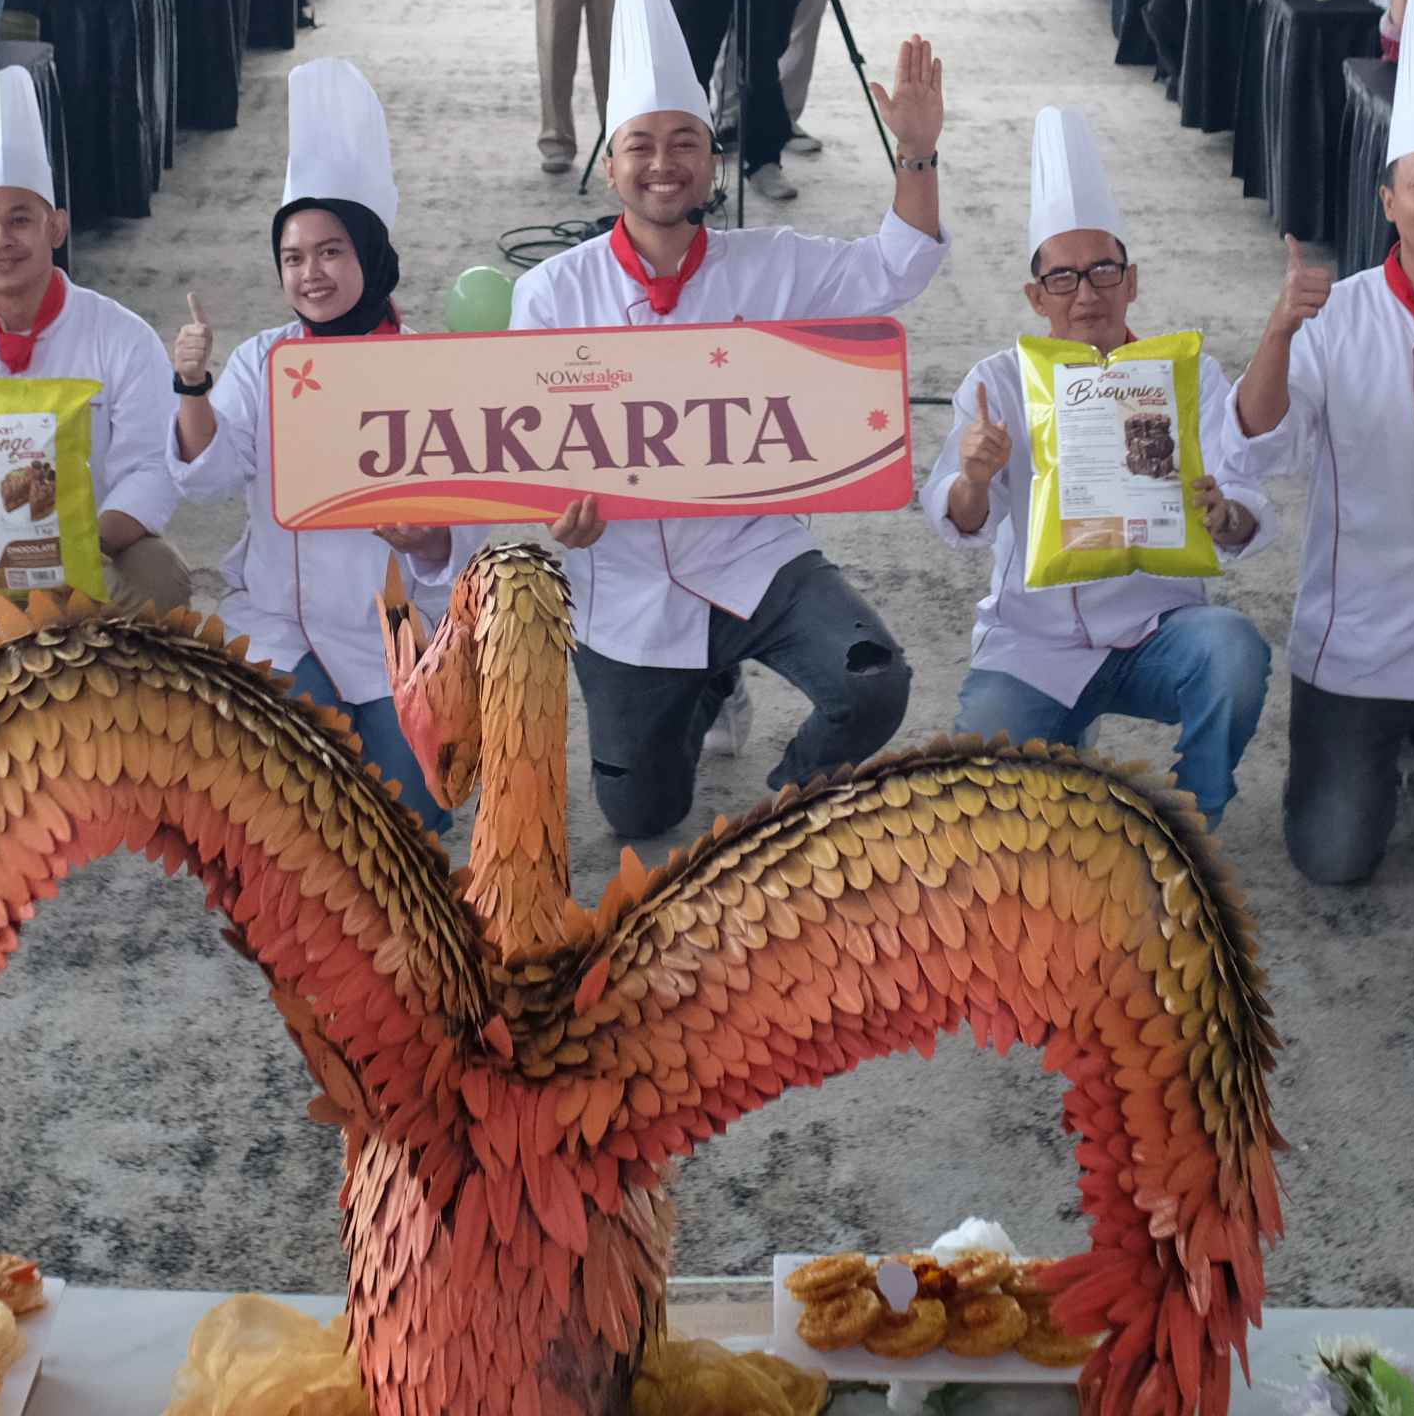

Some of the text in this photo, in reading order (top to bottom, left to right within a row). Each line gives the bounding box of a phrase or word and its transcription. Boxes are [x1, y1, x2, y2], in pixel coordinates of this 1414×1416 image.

[535, 368, 634, 389] NOWstalgia
[1065, 378, 1165, 406] Brownies
[358, 396, 818, 478] JAKARTA
[6, 543, 58, 555] CHOCOLATE
